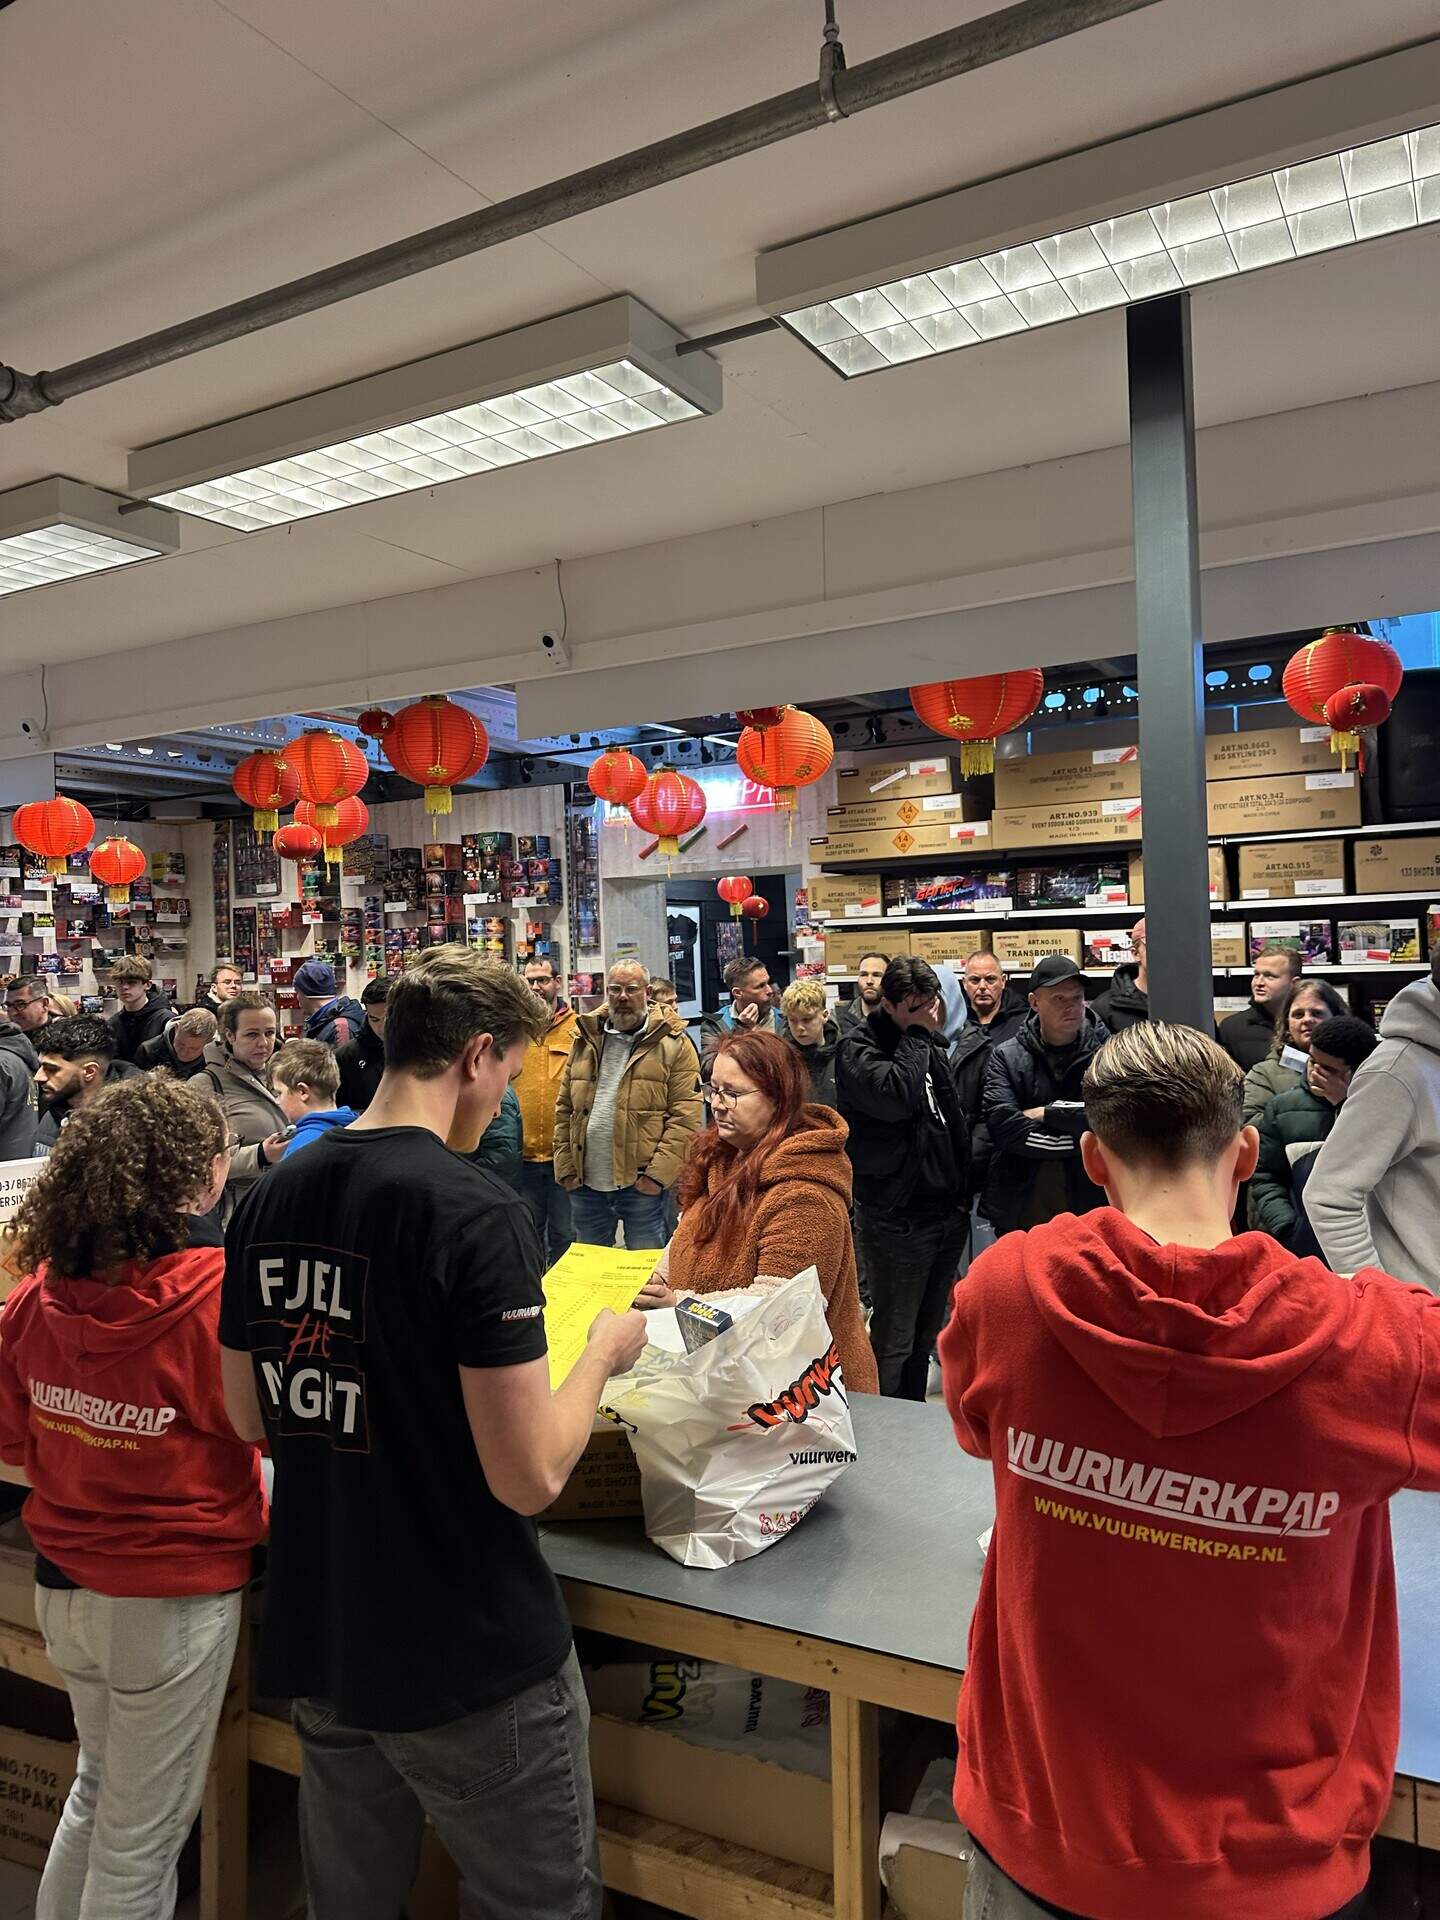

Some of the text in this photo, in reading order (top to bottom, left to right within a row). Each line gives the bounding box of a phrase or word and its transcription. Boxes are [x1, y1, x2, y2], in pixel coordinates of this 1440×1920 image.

[1227, 750, 1257, 760] SKYLINE
[1050, 810, 1098, 820] ART.NO.939
[1265, 861, 1311, 871] ART.NO.915
[1006, 948, 1069, 957] TRANSBOMBER
[29, 1378, 177, 1434] UURWERKPAP
[1007, 1427, 1339, 1535] VUURWERKPAP
[1034, 1496, 1287, 1562] WWW.VUURWERKPAP.NL
